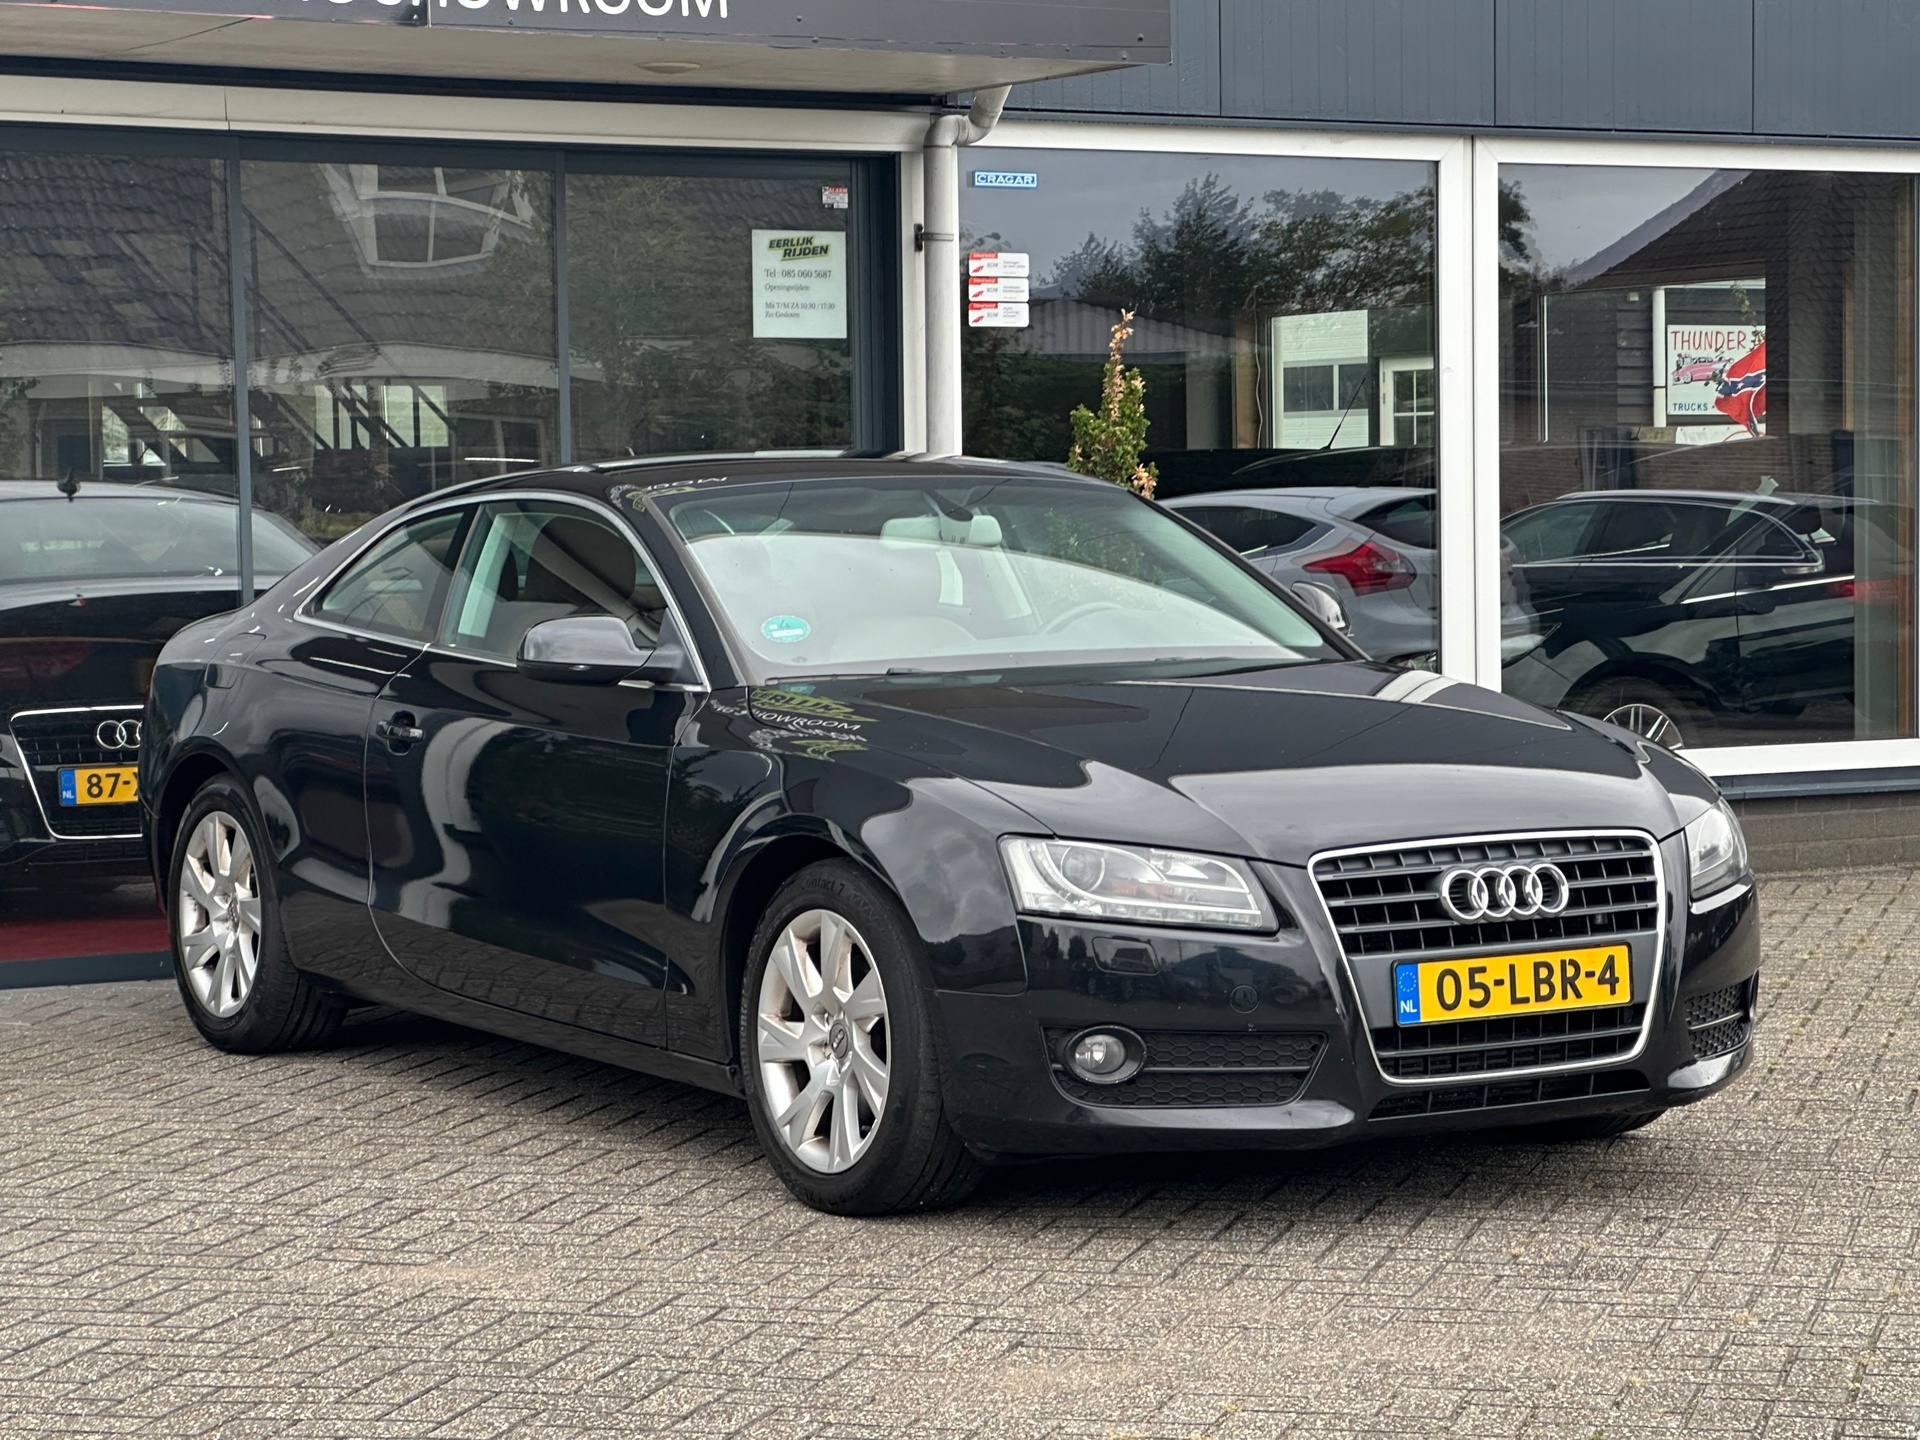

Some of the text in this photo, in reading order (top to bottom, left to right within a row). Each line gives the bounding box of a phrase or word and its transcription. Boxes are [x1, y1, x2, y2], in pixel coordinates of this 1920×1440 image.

[977, 174, 1033, 185] CRAGAR
[768, 236, 814, 249] EERLIJK
[783, 245, 829, 258] RIJDEN
[764, 268, 776, 278] Tel
[781, 269, 796, 278] 085
[797, 269, 813, 279] 060
[814, 270, 832, 279] 5687
[1670, 330, 1747, 351] THUNDER
[1672, 402, 1708, 411] TRUCKS
[62, 790, 75, 799] NL
[1436, 954, 1620, 1011] 05-LBR-4
[1400, 1000, 1418, 1014] NL
